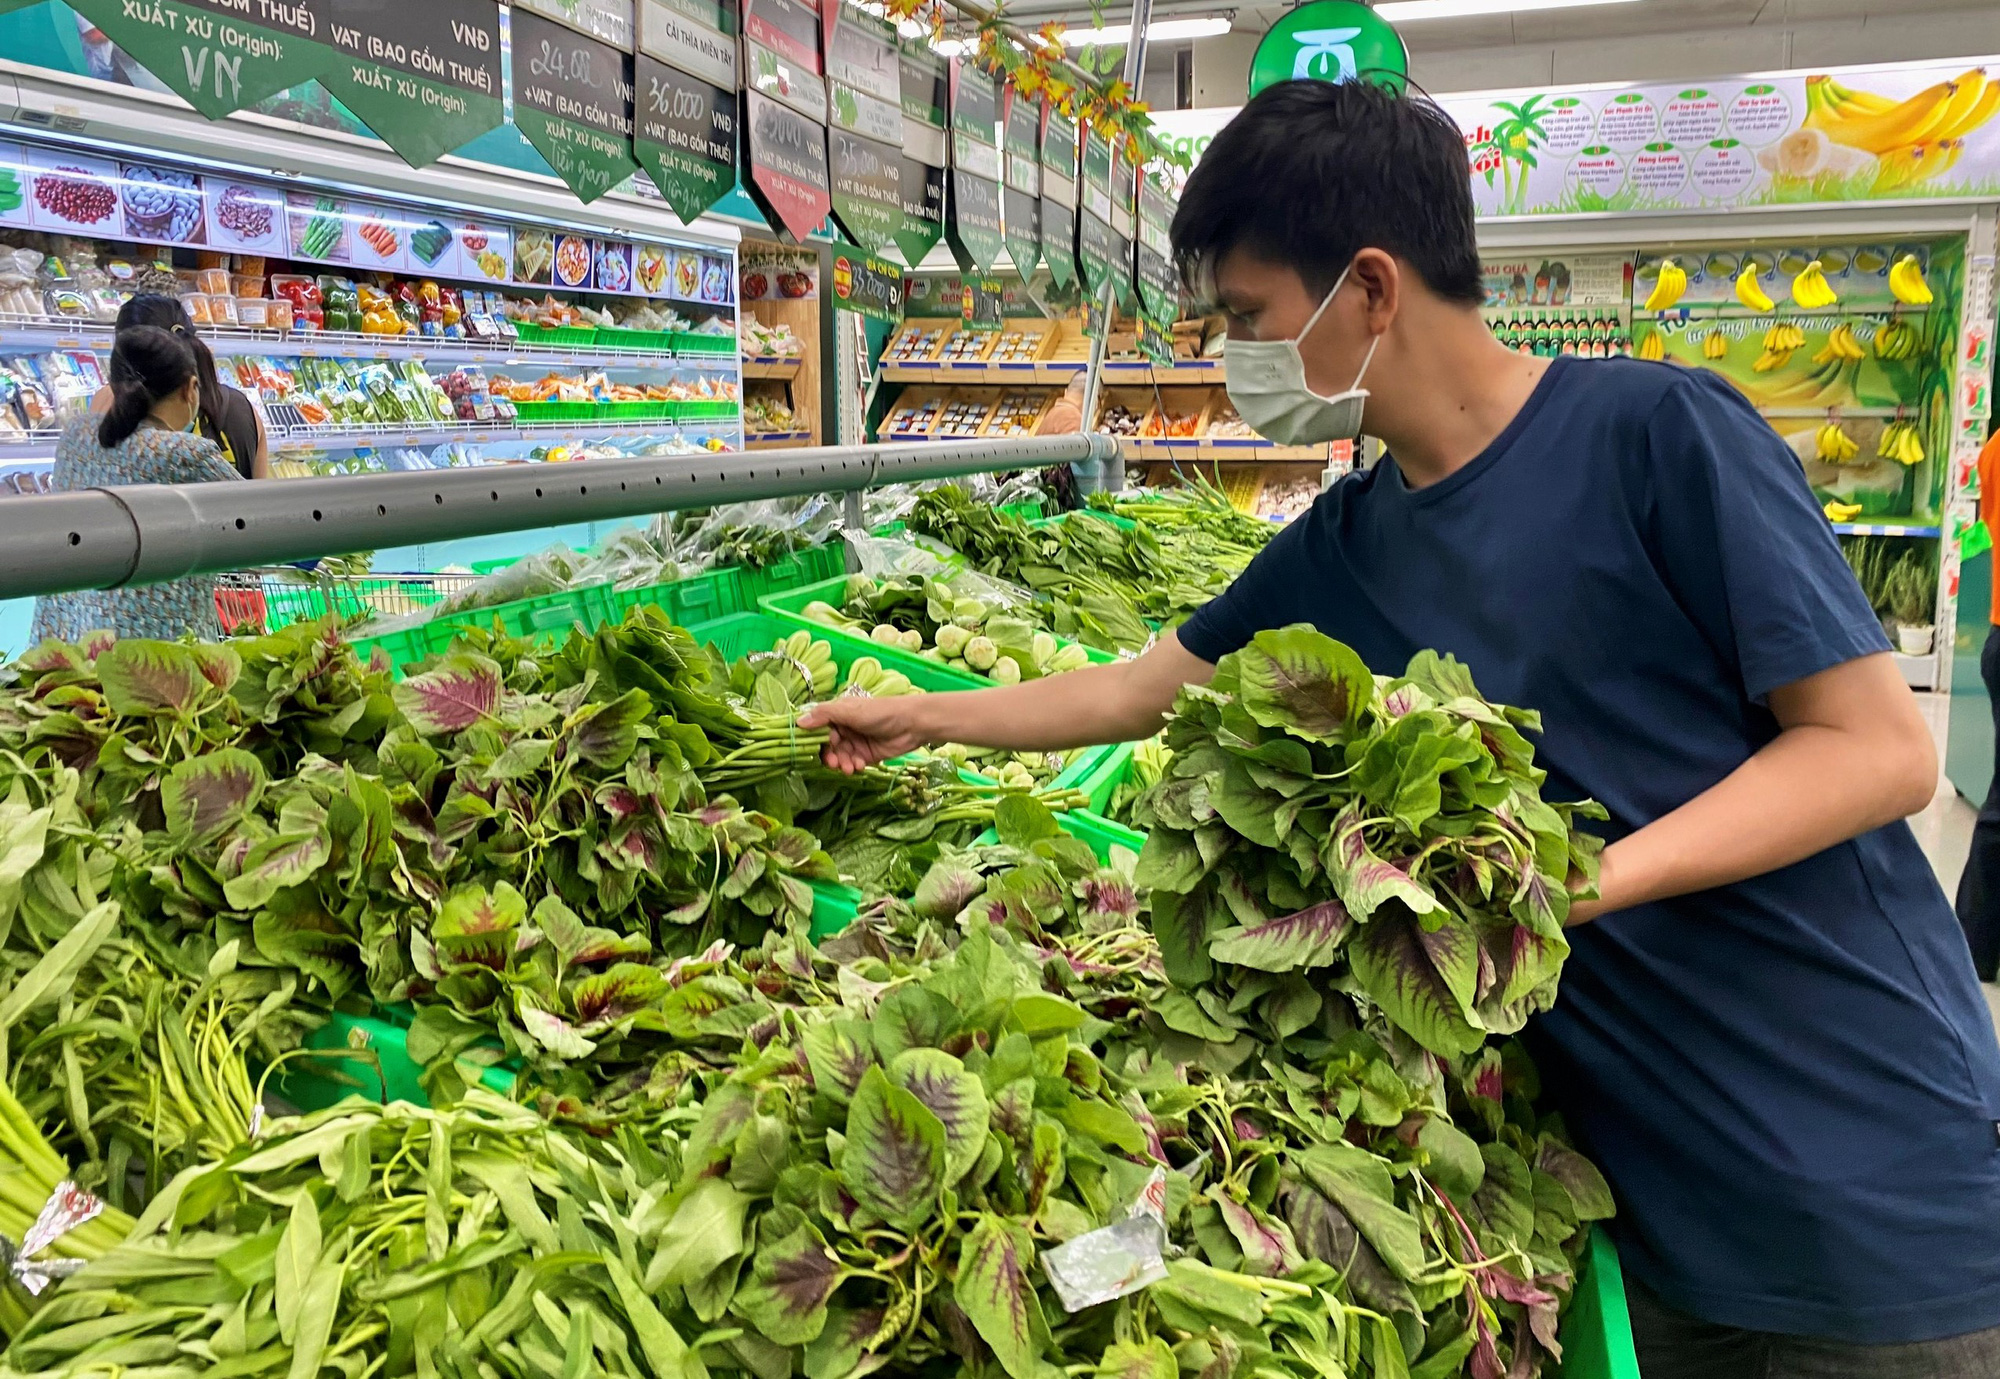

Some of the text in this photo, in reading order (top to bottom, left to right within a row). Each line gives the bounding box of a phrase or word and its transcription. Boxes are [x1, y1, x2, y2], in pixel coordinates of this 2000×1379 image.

[219, 24, 283, 61] (Origin):
[451, 19, 490, 51] VNĐ
[665, 20, 732, 67] CẢI THÌA MIỀN TÂY
[181, 45, 243, 105] VN
[367, 35, 406, 64] (BAO
[410, 45, 445, 77] GỒM
[448, 60, 492, 94] THUẾ)
[352, 65, 392, 92] XUẤT
[421, 86, 467, 116] (Origin):
[524, 85, 553, 107] +VAT
[556, 95, 582, 117] (BAO
[585, 101, 608, 127] GỒM
[649, 76, 703, 120] 36.000
[644, 121, 666, 141] +VAT
[668, 128, 688, 148] (BAO
[689, 132, 708, 154] GỒM
[711, 110, 732, 132] VNĐ
[591, 135, 623, 160] (Origin):
